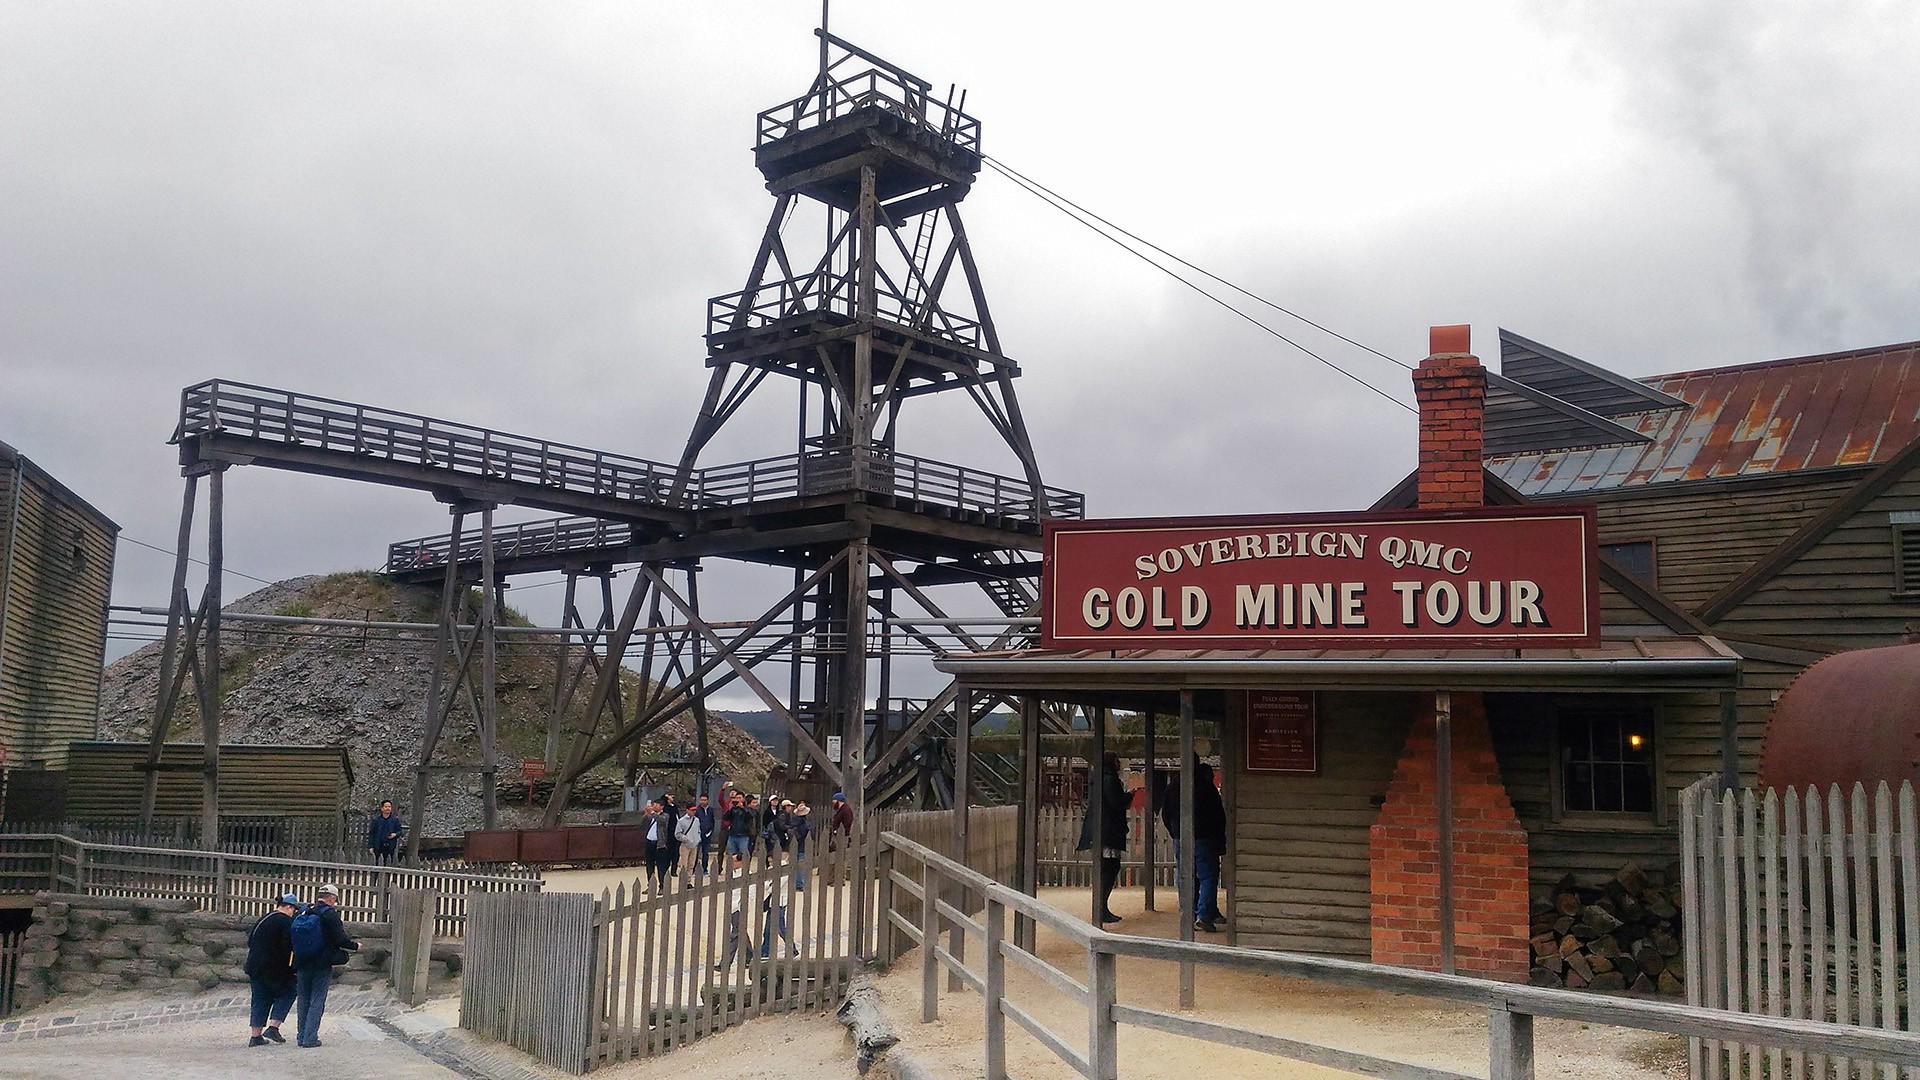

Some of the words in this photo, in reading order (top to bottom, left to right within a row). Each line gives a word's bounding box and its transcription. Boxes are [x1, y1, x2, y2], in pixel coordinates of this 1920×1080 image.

[1134, 531, 1369, 580] SOVEREIGN
[1379, 536, 1472, 574] QMC
[1082, 586, 1210, 628] GOLD
[1235, 582, 1367, 627] MINE
[1392, 580, 1547, 626] TOUR
